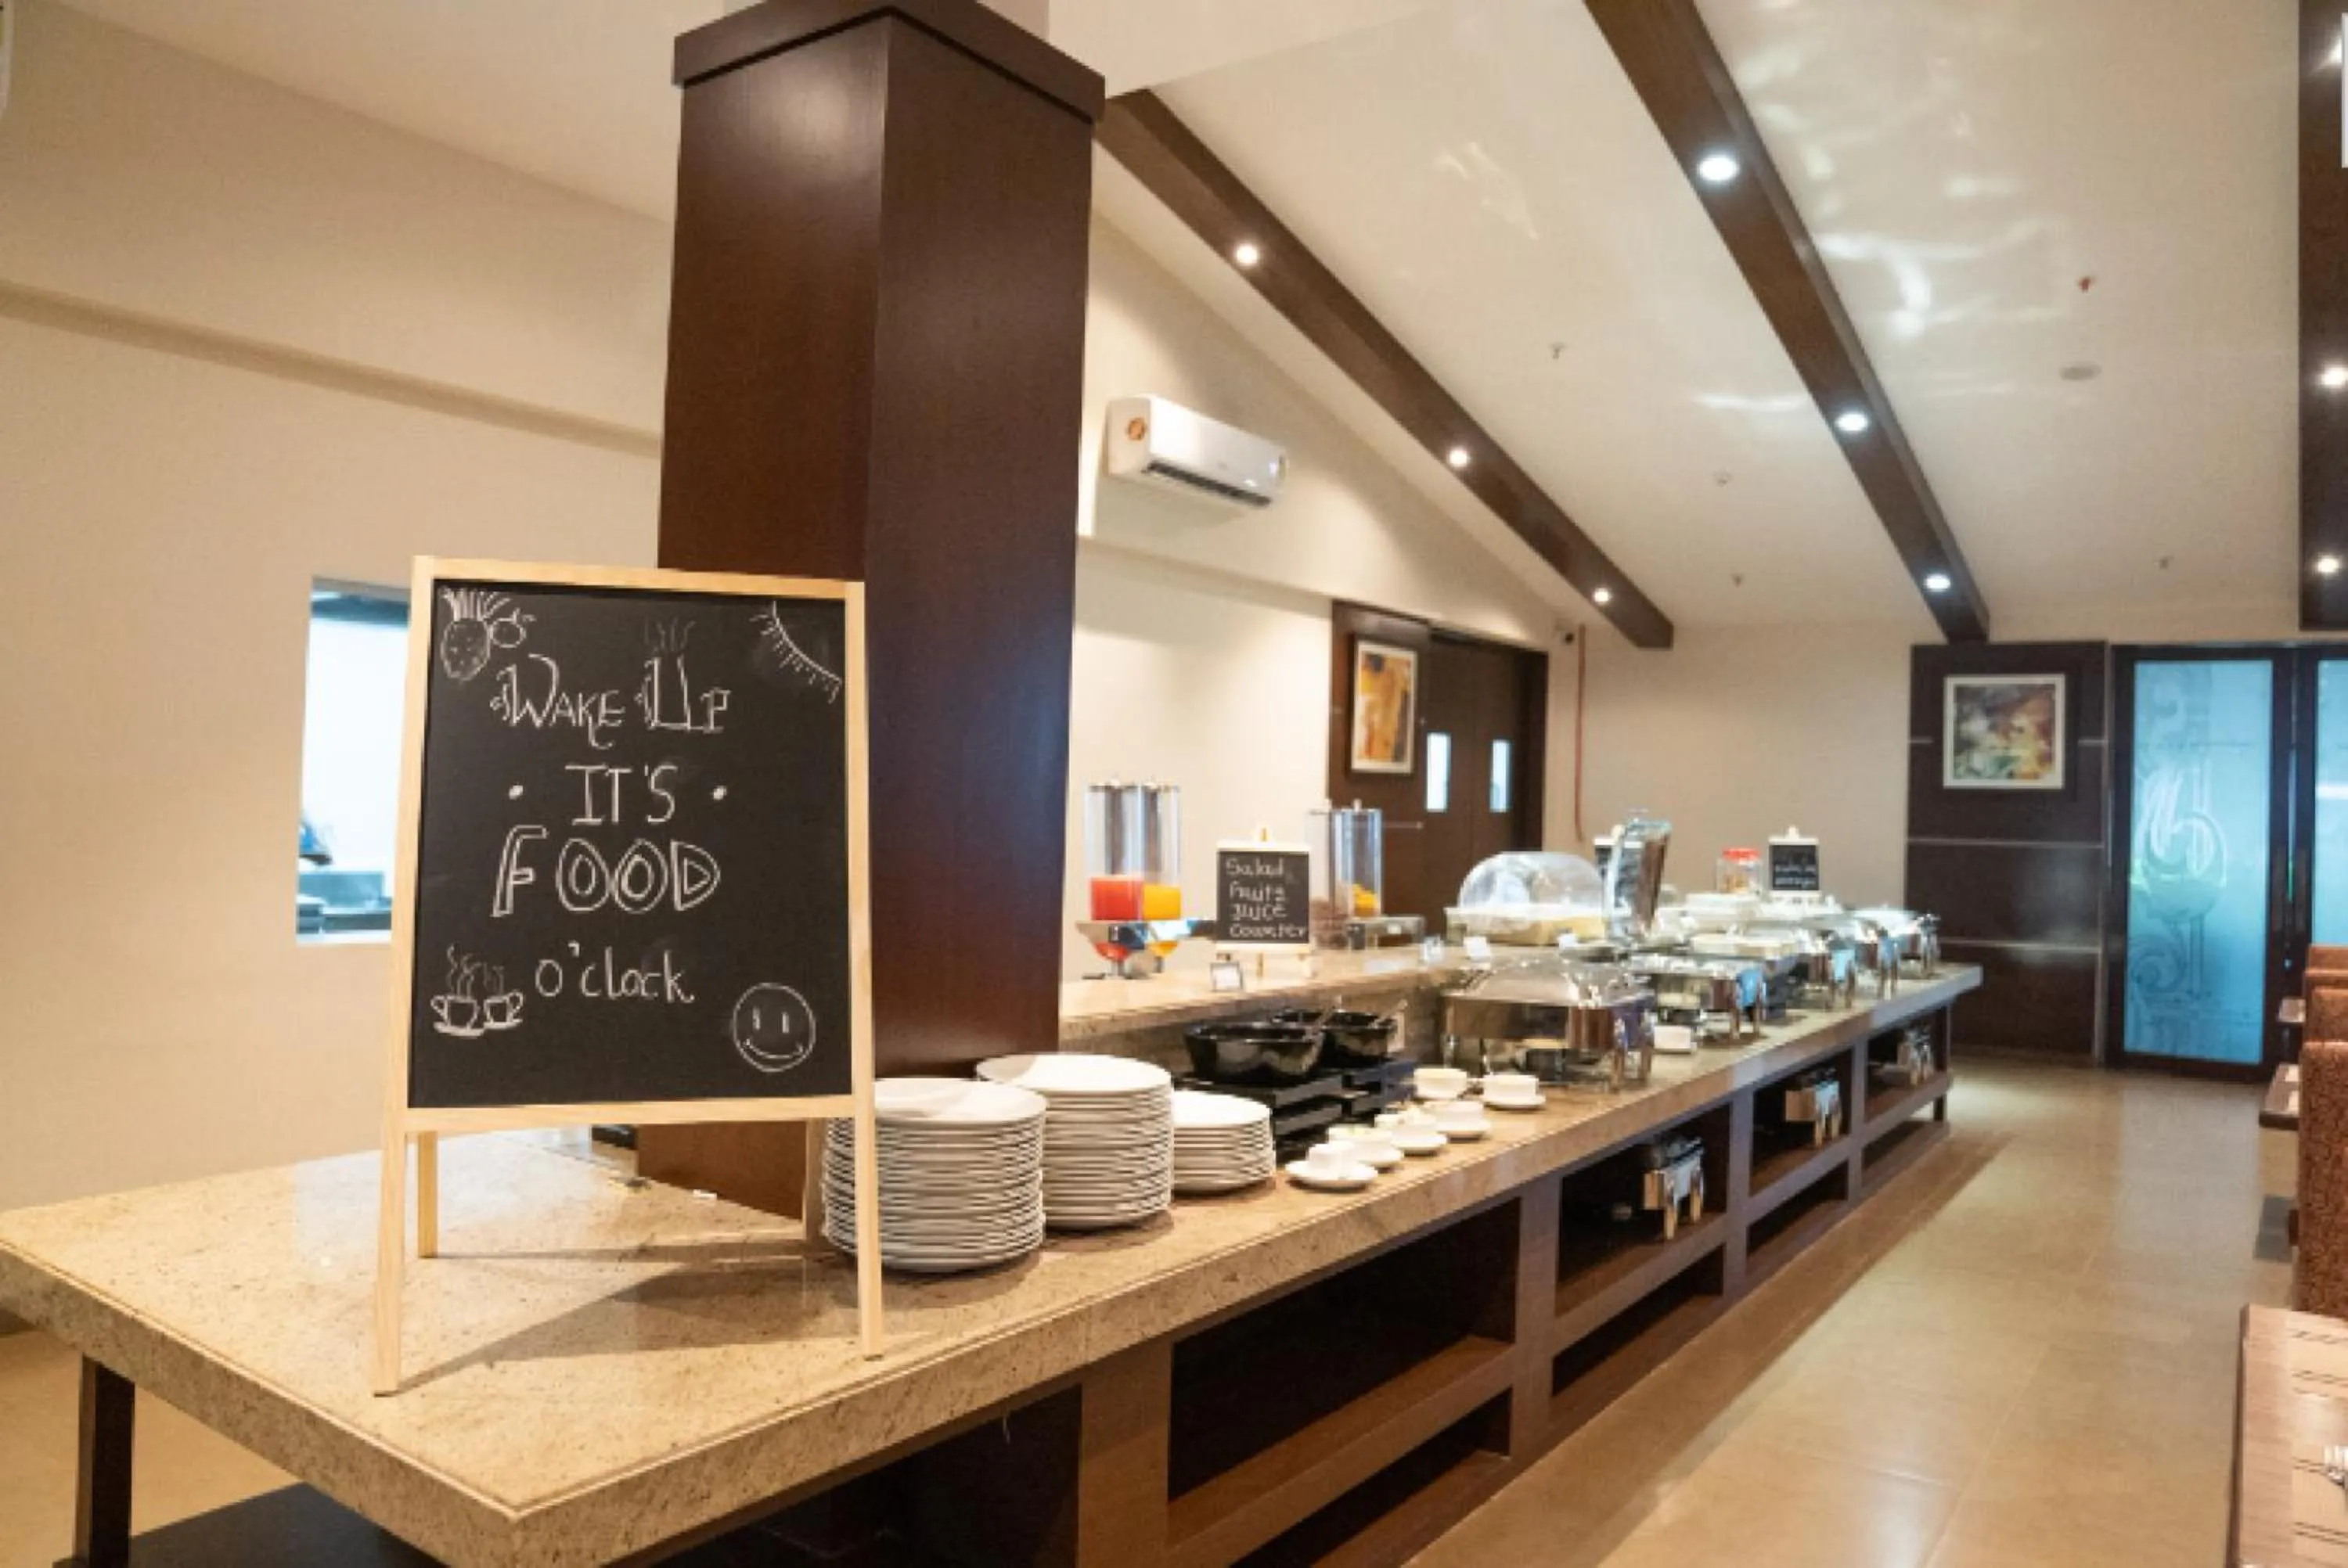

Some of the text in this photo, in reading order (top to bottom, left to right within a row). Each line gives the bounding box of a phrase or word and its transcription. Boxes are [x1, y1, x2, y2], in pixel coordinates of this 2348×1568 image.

[490, 653, 731, 750] WAKE UP
[564, 762, 679, 825] IT'S
[490, 824, 721, 917] FOOD
[535, 940, 695, 1004] o'clock
